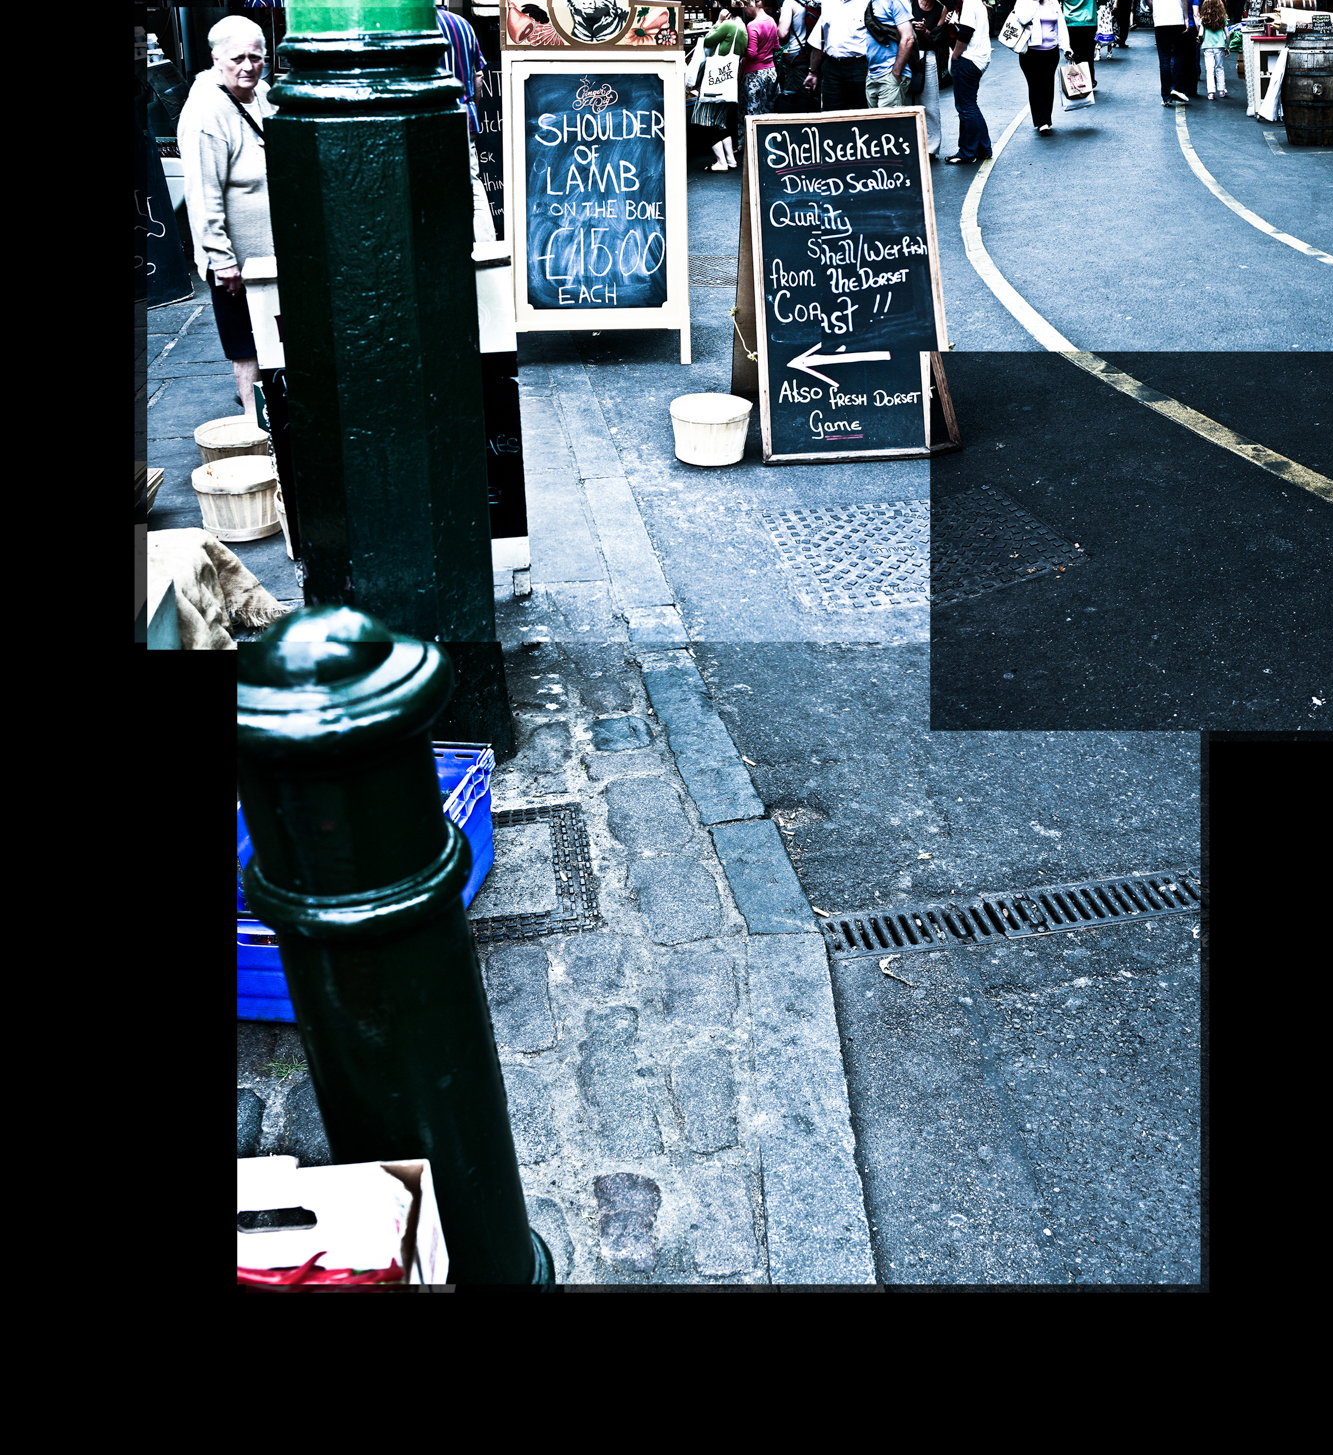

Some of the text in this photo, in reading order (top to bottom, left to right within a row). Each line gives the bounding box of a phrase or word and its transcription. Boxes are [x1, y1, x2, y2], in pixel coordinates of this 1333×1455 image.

[708, 70, 734, 86] SACK
[718, 62, 732, 76] MY
[535, 109, 665, 146] SHOULDER
[574, 144, 600, 164] OF
[546, 160, 640, 195] LAMB
[550, 199, 664, 220] ON THE BONE
[558, 282, 617, 305] EACH
[809, 410, 862, 439] Game
